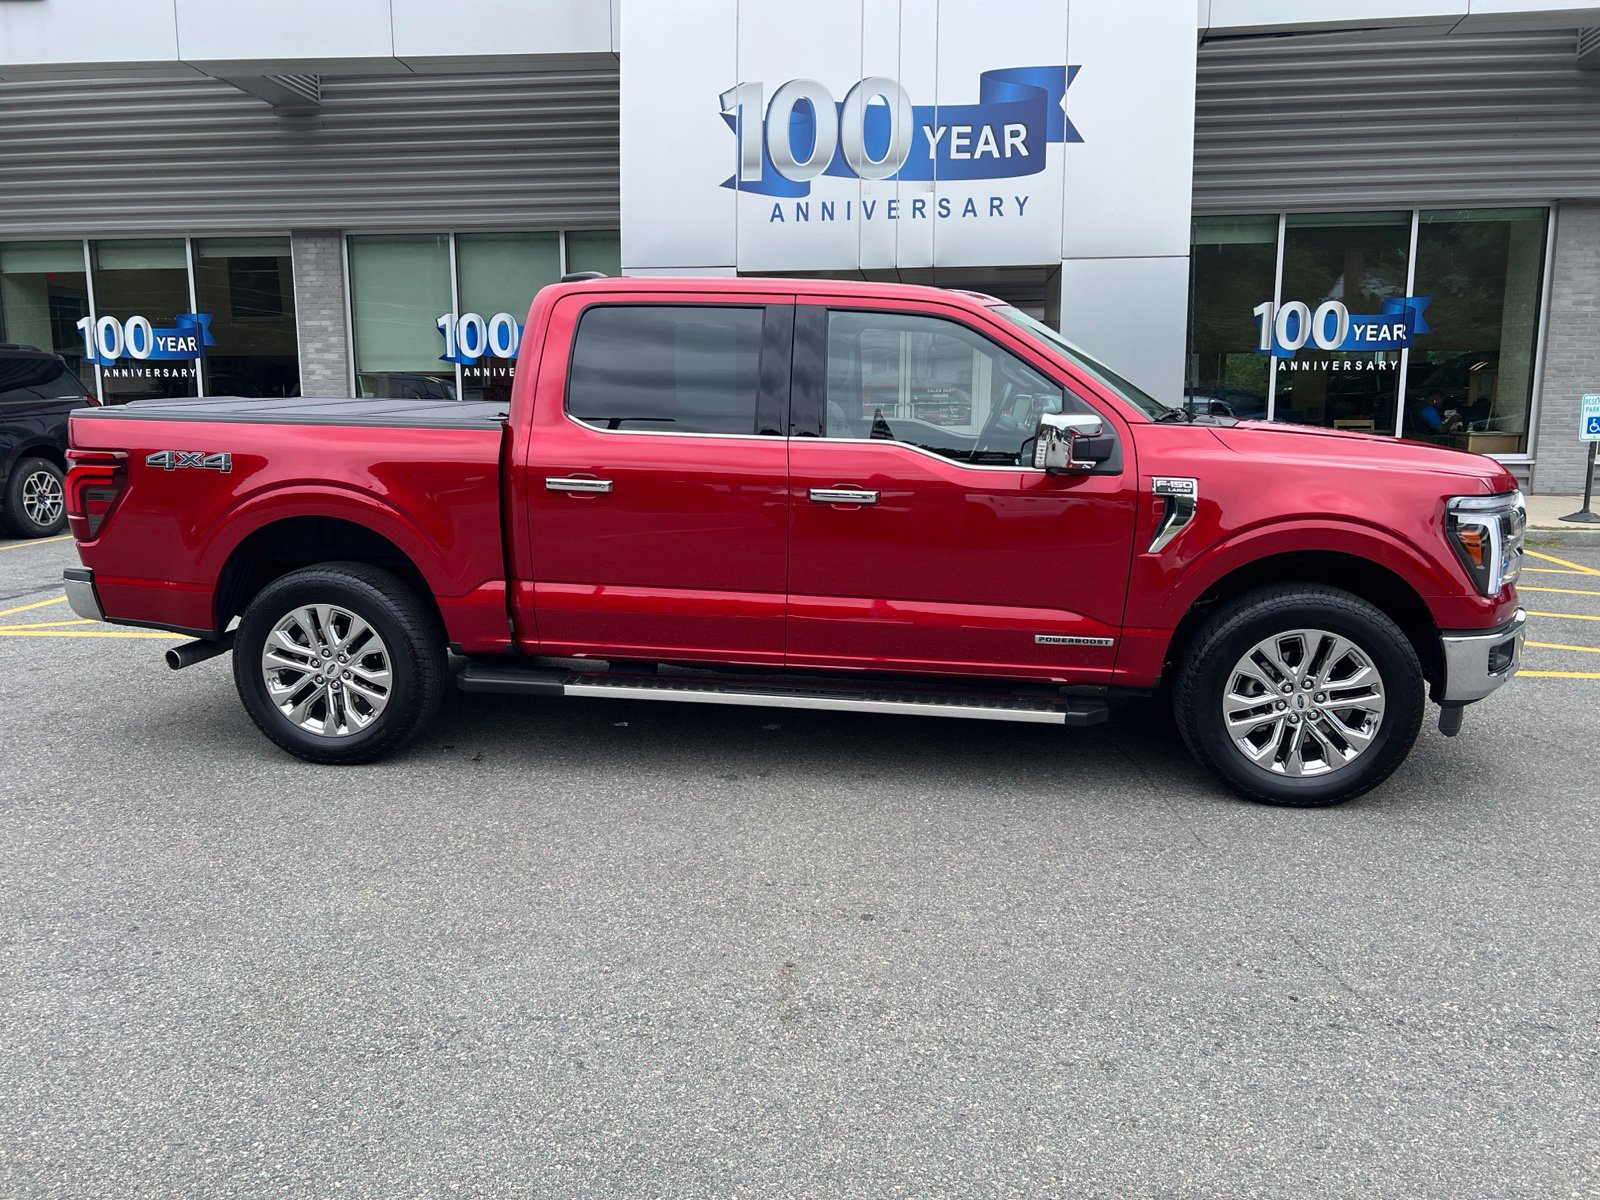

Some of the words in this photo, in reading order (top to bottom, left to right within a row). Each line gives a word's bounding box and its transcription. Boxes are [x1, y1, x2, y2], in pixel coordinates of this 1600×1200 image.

[718, 76, 914, 182] 100
[922, 123, 1030, 160] YEAR
[769, 195, 1029, 223] ANNIVERSARY
[76, 315, 153, 360] 100
[156, 336, 198, 352] YEAR
[436, 312, 519, 358] 100
[1253, 300, 1350, 350] 100
[1353, 324, 1406, 341] YEAR
[103, 368, 197, 378] ANNIVERSARY
[1278, 360, 1398, 371] ANNIVERSARY
[1156, 480, 1193, 488] F-150
[1038, 636, 1111, 645] POWERBOOST
